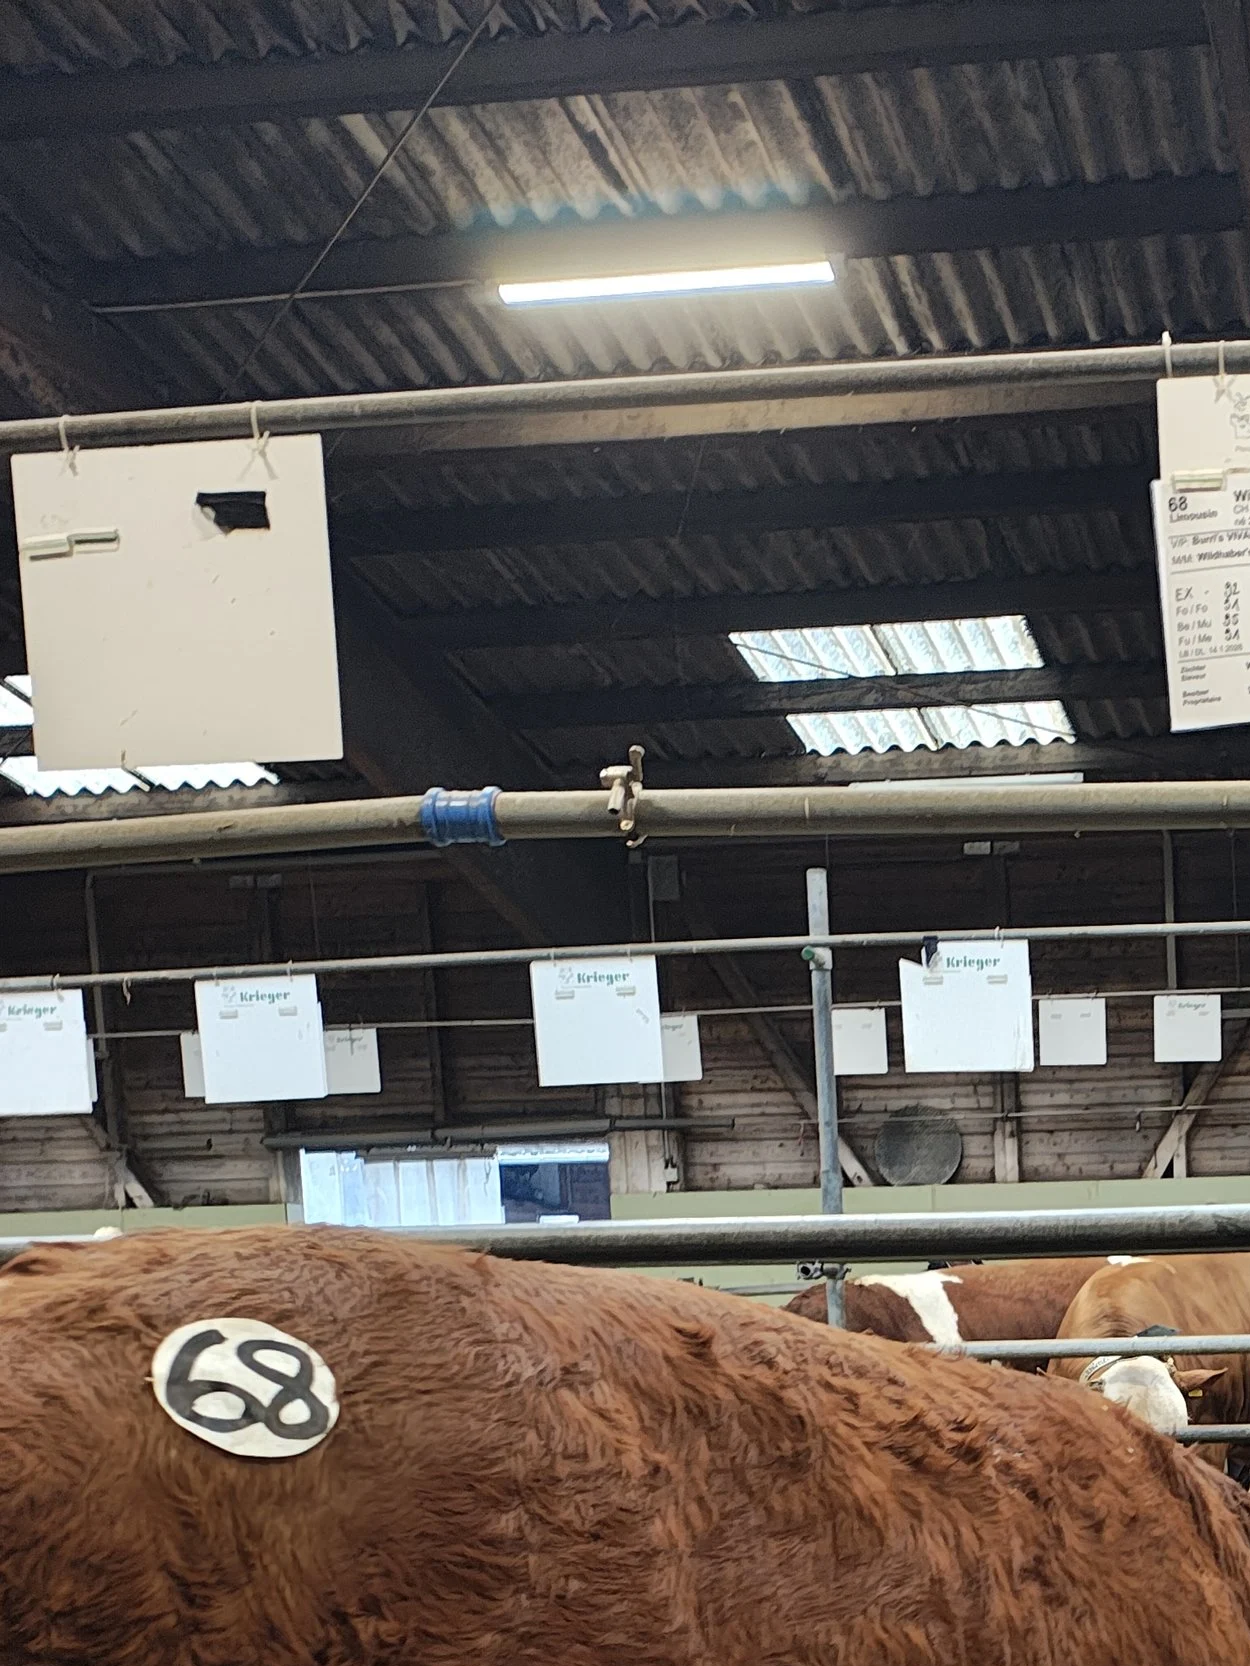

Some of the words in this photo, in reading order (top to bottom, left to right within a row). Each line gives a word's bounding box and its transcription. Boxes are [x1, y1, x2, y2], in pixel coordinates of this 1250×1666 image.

[1168, 496, 1188, 512] 68
[946, 955, 1001, 971] Krieger
[577, 971, 630, 985] Krieger
[240, 990, 291, 1004] Krieger
[7, 1003, 57, 1019] Krieger
[165, 1328, 330, 1440] 68
